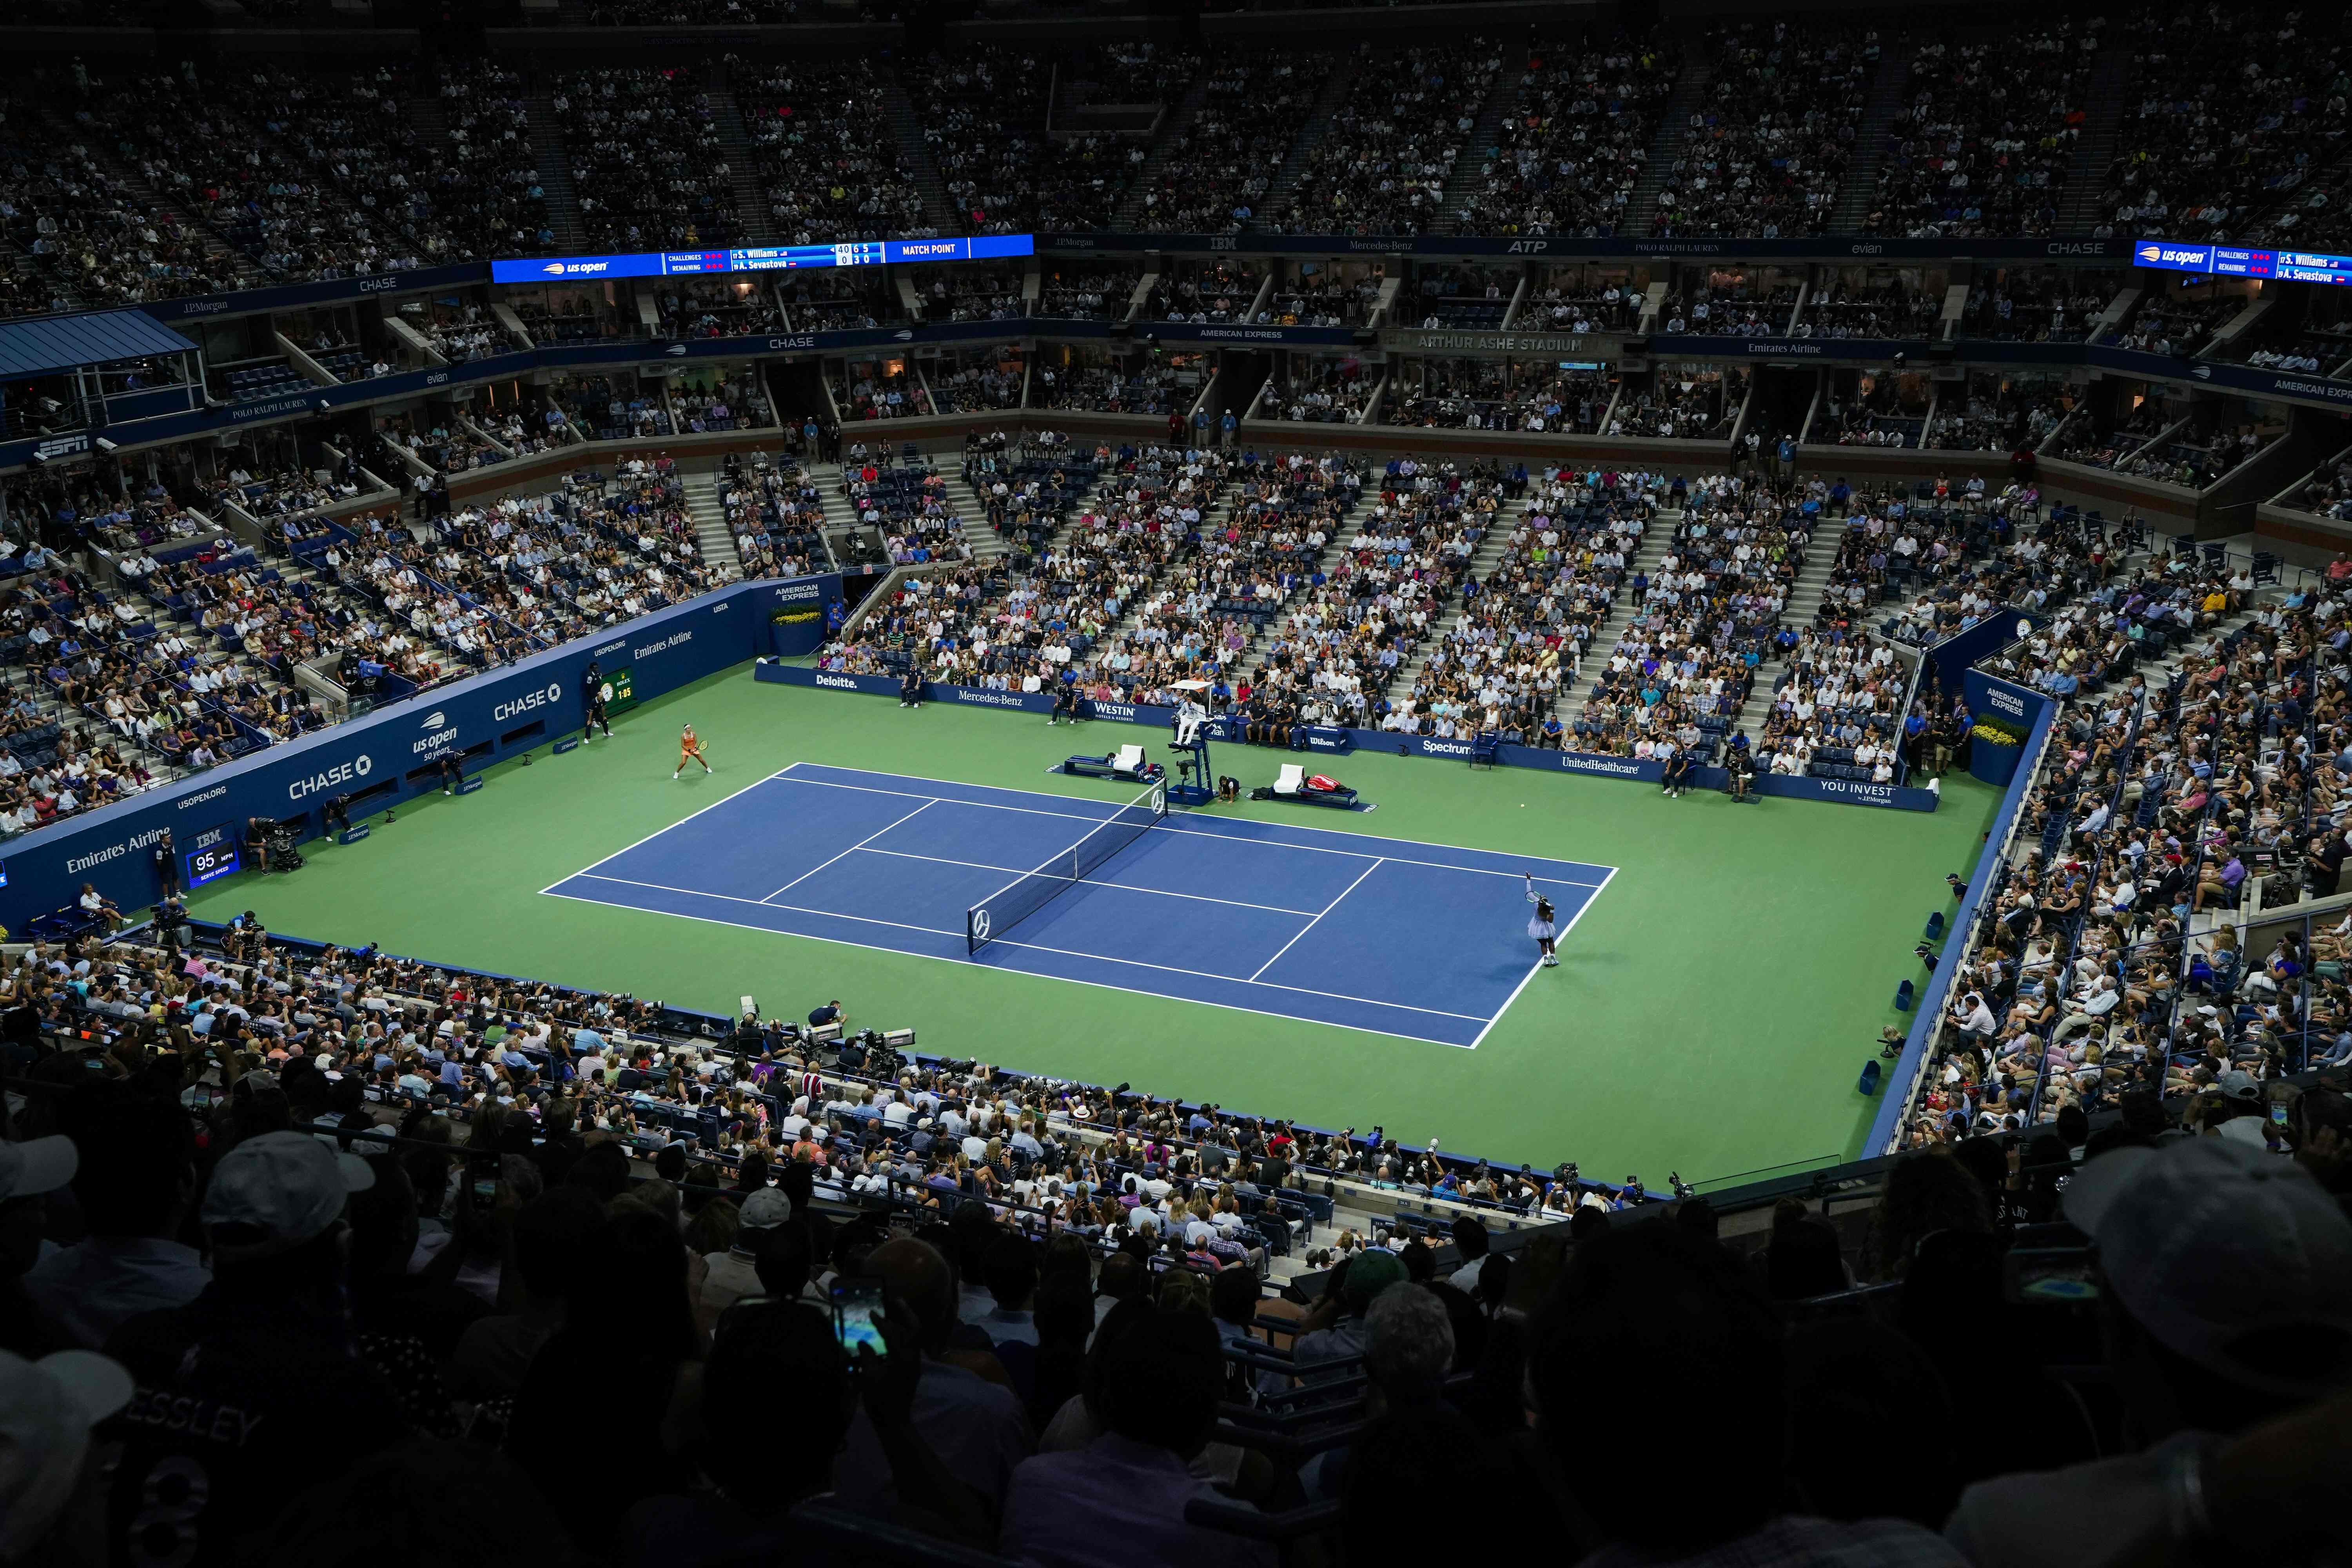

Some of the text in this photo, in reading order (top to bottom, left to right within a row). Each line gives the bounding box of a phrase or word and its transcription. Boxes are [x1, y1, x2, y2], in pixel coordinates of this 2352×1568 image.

[838, 244, 869, 253] 40 6 5
[902, 243, 956, 256] MATCH POINT
[1055, 238, 1094, 248] J.P.Morgan
[1210, 237, 1236, 250] IBM
[1349, 241, 1412, 252] Mercedes-Benz
[1507, 241, 1548, 253] ATP
[1852, 242, 1882, 254] evian
[2047, 243, 2105, 254] CHASE
[746, 249, 778, 258] Williams
[854, 255, 860, 264] 3
[863, 255, 869, 263] 0
[2161, 250, 2205, 265] us open
[2217, 250, 2249, 260] CHALLENGES
[739, 261, 747, 270] A.
[748, 260, 787, 269] Sevastova
[2218, 262, 2246, 272] REMAINING
[2285, 254, 2294, 265] S.
[2295, 254, 2328, 268] Williams
[567, 263, 607, 274] us open
[2283, 268, 2291, 279] A.
[2293, 269, 2332, 283] Sevastova
[359, 277, 397, 292] CHASE
[183, 301, 228, 314] J.P.Morgan
[769, 337, 814, 348] CHASE
[1418, 335, 1583, 352] ARTHUR ASHE STADIUM
[1748, 343, 1821, 354] Emirates Airline
[427, 372, 448, 384] evian
[2274, 379, 2352, 400] AMERICAN EXPR
[232, 398, 307, 419] POLO RALPH LAUREN
[39, 434, 88, 457] ESPN
[775, 583, 818, 596] AMERICAN
[782, 590, 819, 601] EXPRESS
[713, 603, 729, 613] USTA
[594, 640, 626, 657] USOPEN.ORG
[634, 630, 692, 660] Emirates Airline
[616, 677, 631, 687] ROLEX
[816, 674, 857, 689] Deloitte.
[618, 687, 631, 700] 1:05
[958, 690, 1022, 706] Mercedes-Benz
[1987, 687, 2024, 708] AMERICAN
[494, 689, 546, 721] CHASE
[1094, 702, 1134, 717] WESTIN
[1991, 697, 2023, 717] EXPRESS
[413, 727, 457, 754] us open
[1310, 737, 1336, 747] Wilson
[1423, 740, 1472, 755] Spectrum
[423, 745, 451, 761] 50 years
[1562, 756, 1639, 775] UnitedHealthcare
[289, 761, 353, 800] CHASE
[463, 780, 482, 792] J.P.Morgan
[1820, 780, 1893, 797] YOU INVEST
[178, 786, 227, 809] USOPEN.ORG
[1862, 796, 1891, 804] J.P.Morgan
[196, 829, 222, 849] IBM
[348, 828, 369, 841] J.P.Morgan
[66, 827, 170, 874] Emirates Airline
[196, 851, 234, 871] 95 MPH
[200, 866, 229, 881] SERVE SPEED
[125, 1387, 264, 1447] ESSLEY
